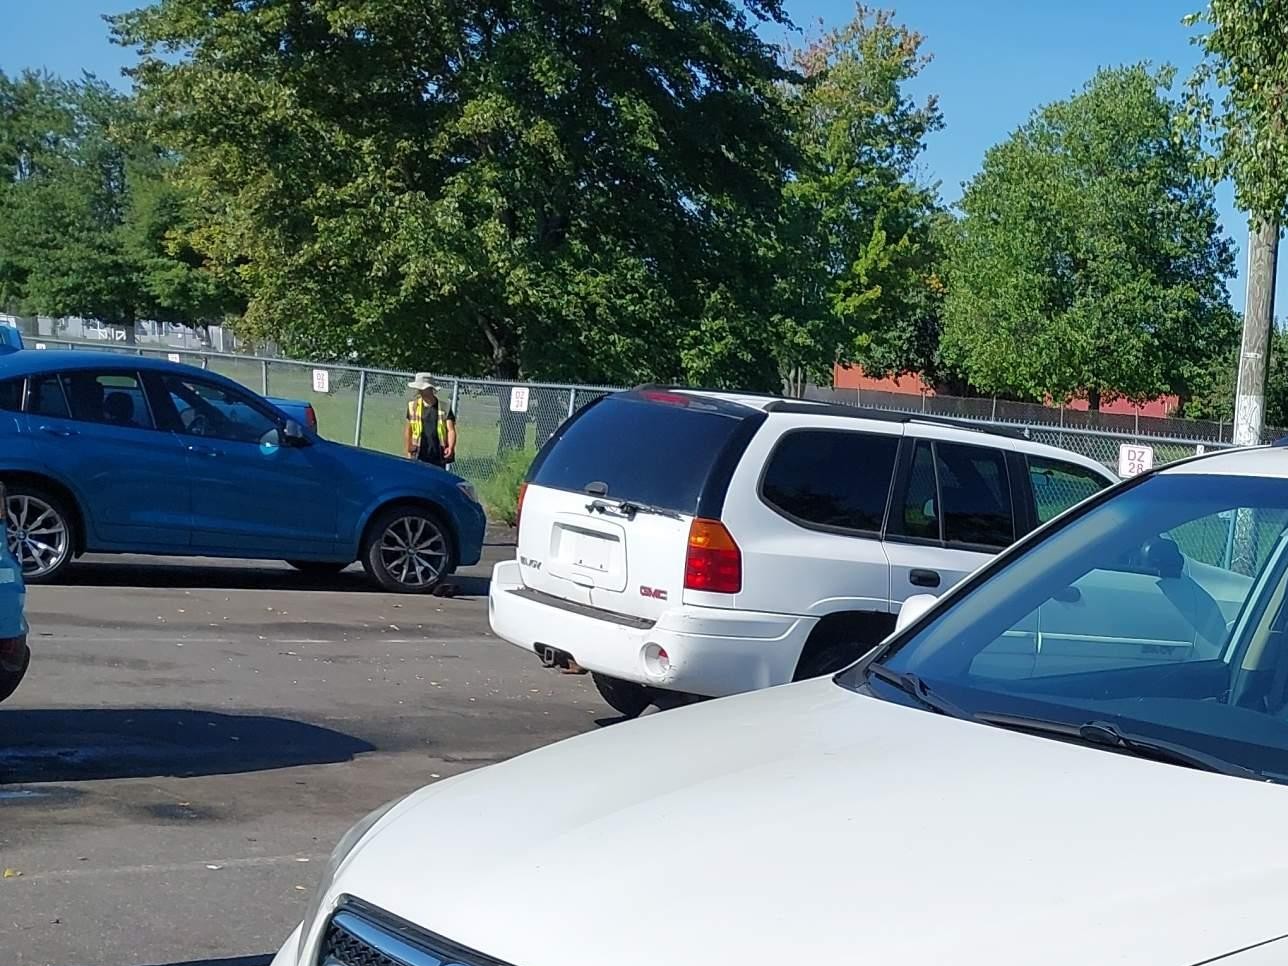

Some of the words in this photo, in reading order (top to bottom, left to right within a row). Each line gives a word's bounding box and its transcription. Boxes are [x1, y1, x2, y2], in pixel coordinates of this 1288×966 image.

[1128, 450, 1145, 462] DZ
[1128, 463, 1144, 474] 28
[639, 585, 668, 601] GMC
